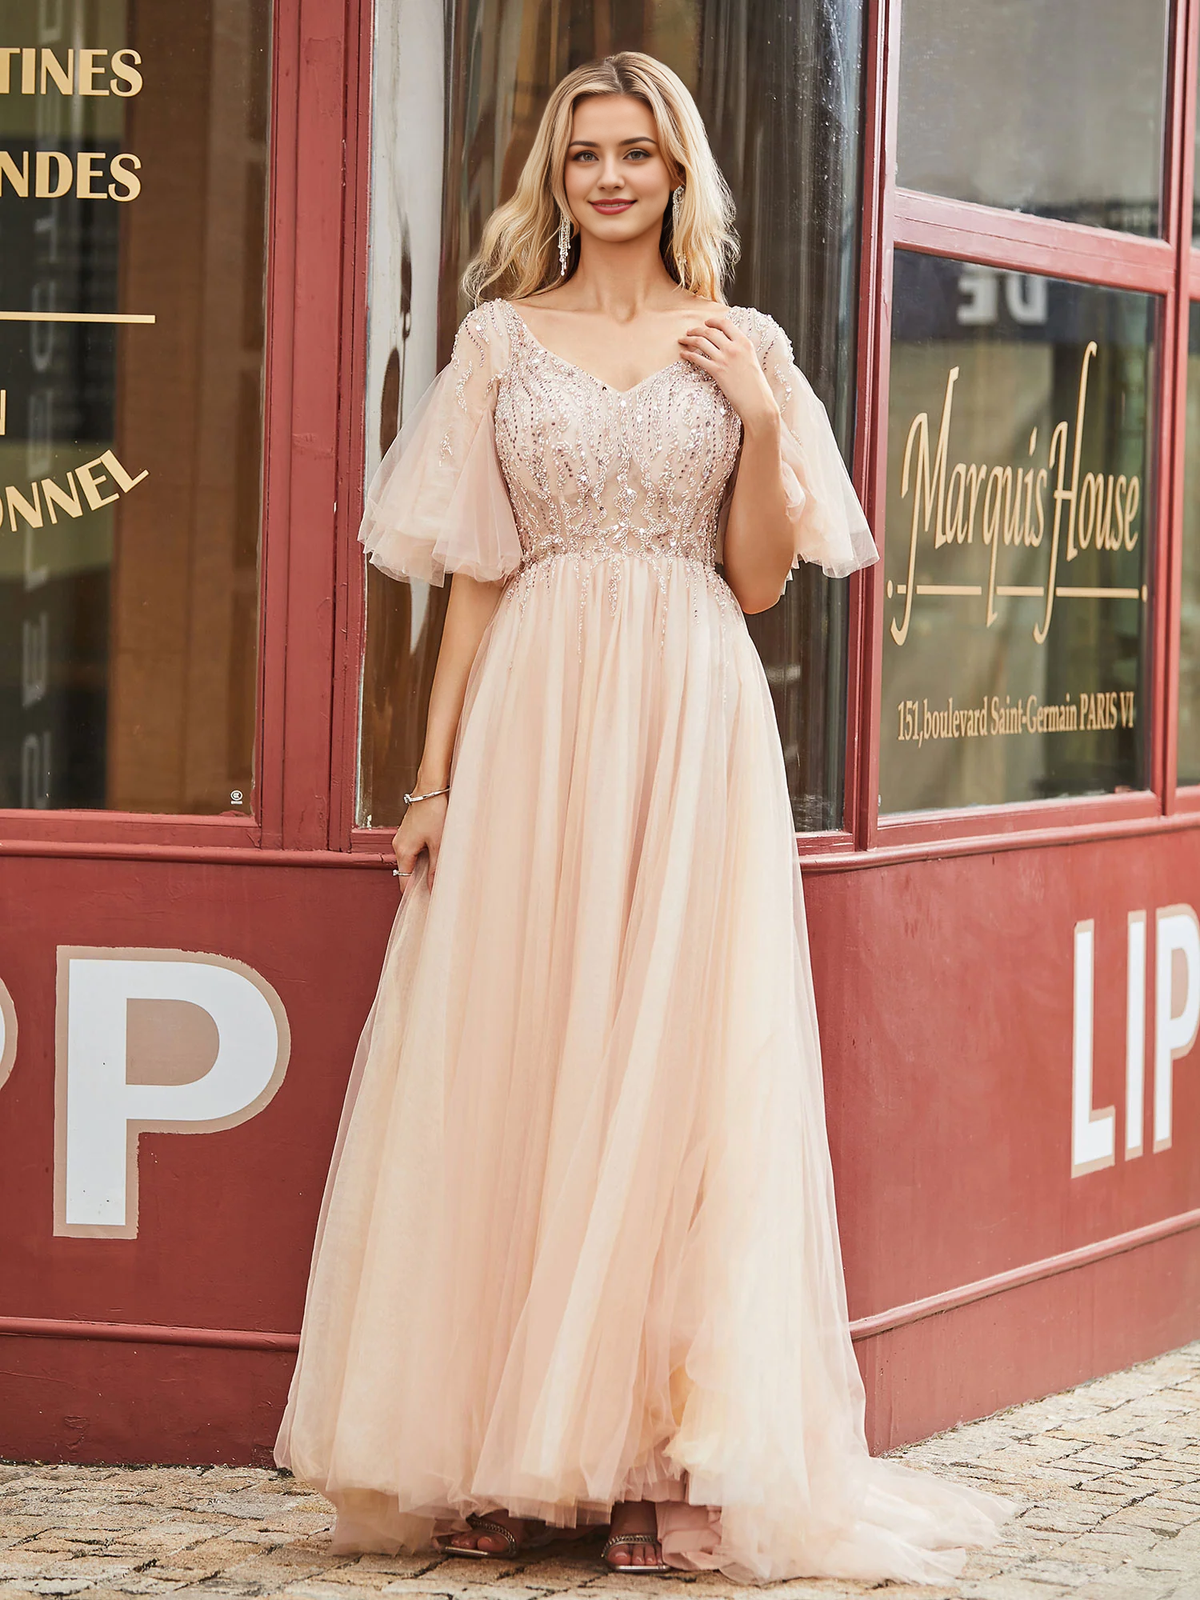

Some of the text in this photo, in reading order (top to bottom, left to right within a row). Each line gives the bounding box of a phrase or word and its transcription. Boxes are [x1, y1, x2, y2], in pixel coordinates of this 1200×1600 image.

[0, 47, 143, 97] TINES
[0, 151, 142, 202] NDES
[0, 449, 149, 532] NNEL
[991, 693, 1077, 736] Saint-Germain
[1079, 691, 1118, 731] PARIS
[1120, 691, 1135, 729] VI
[1071, 903, 1200, 1179] LIP
[0, 945, 291, 1239] P
